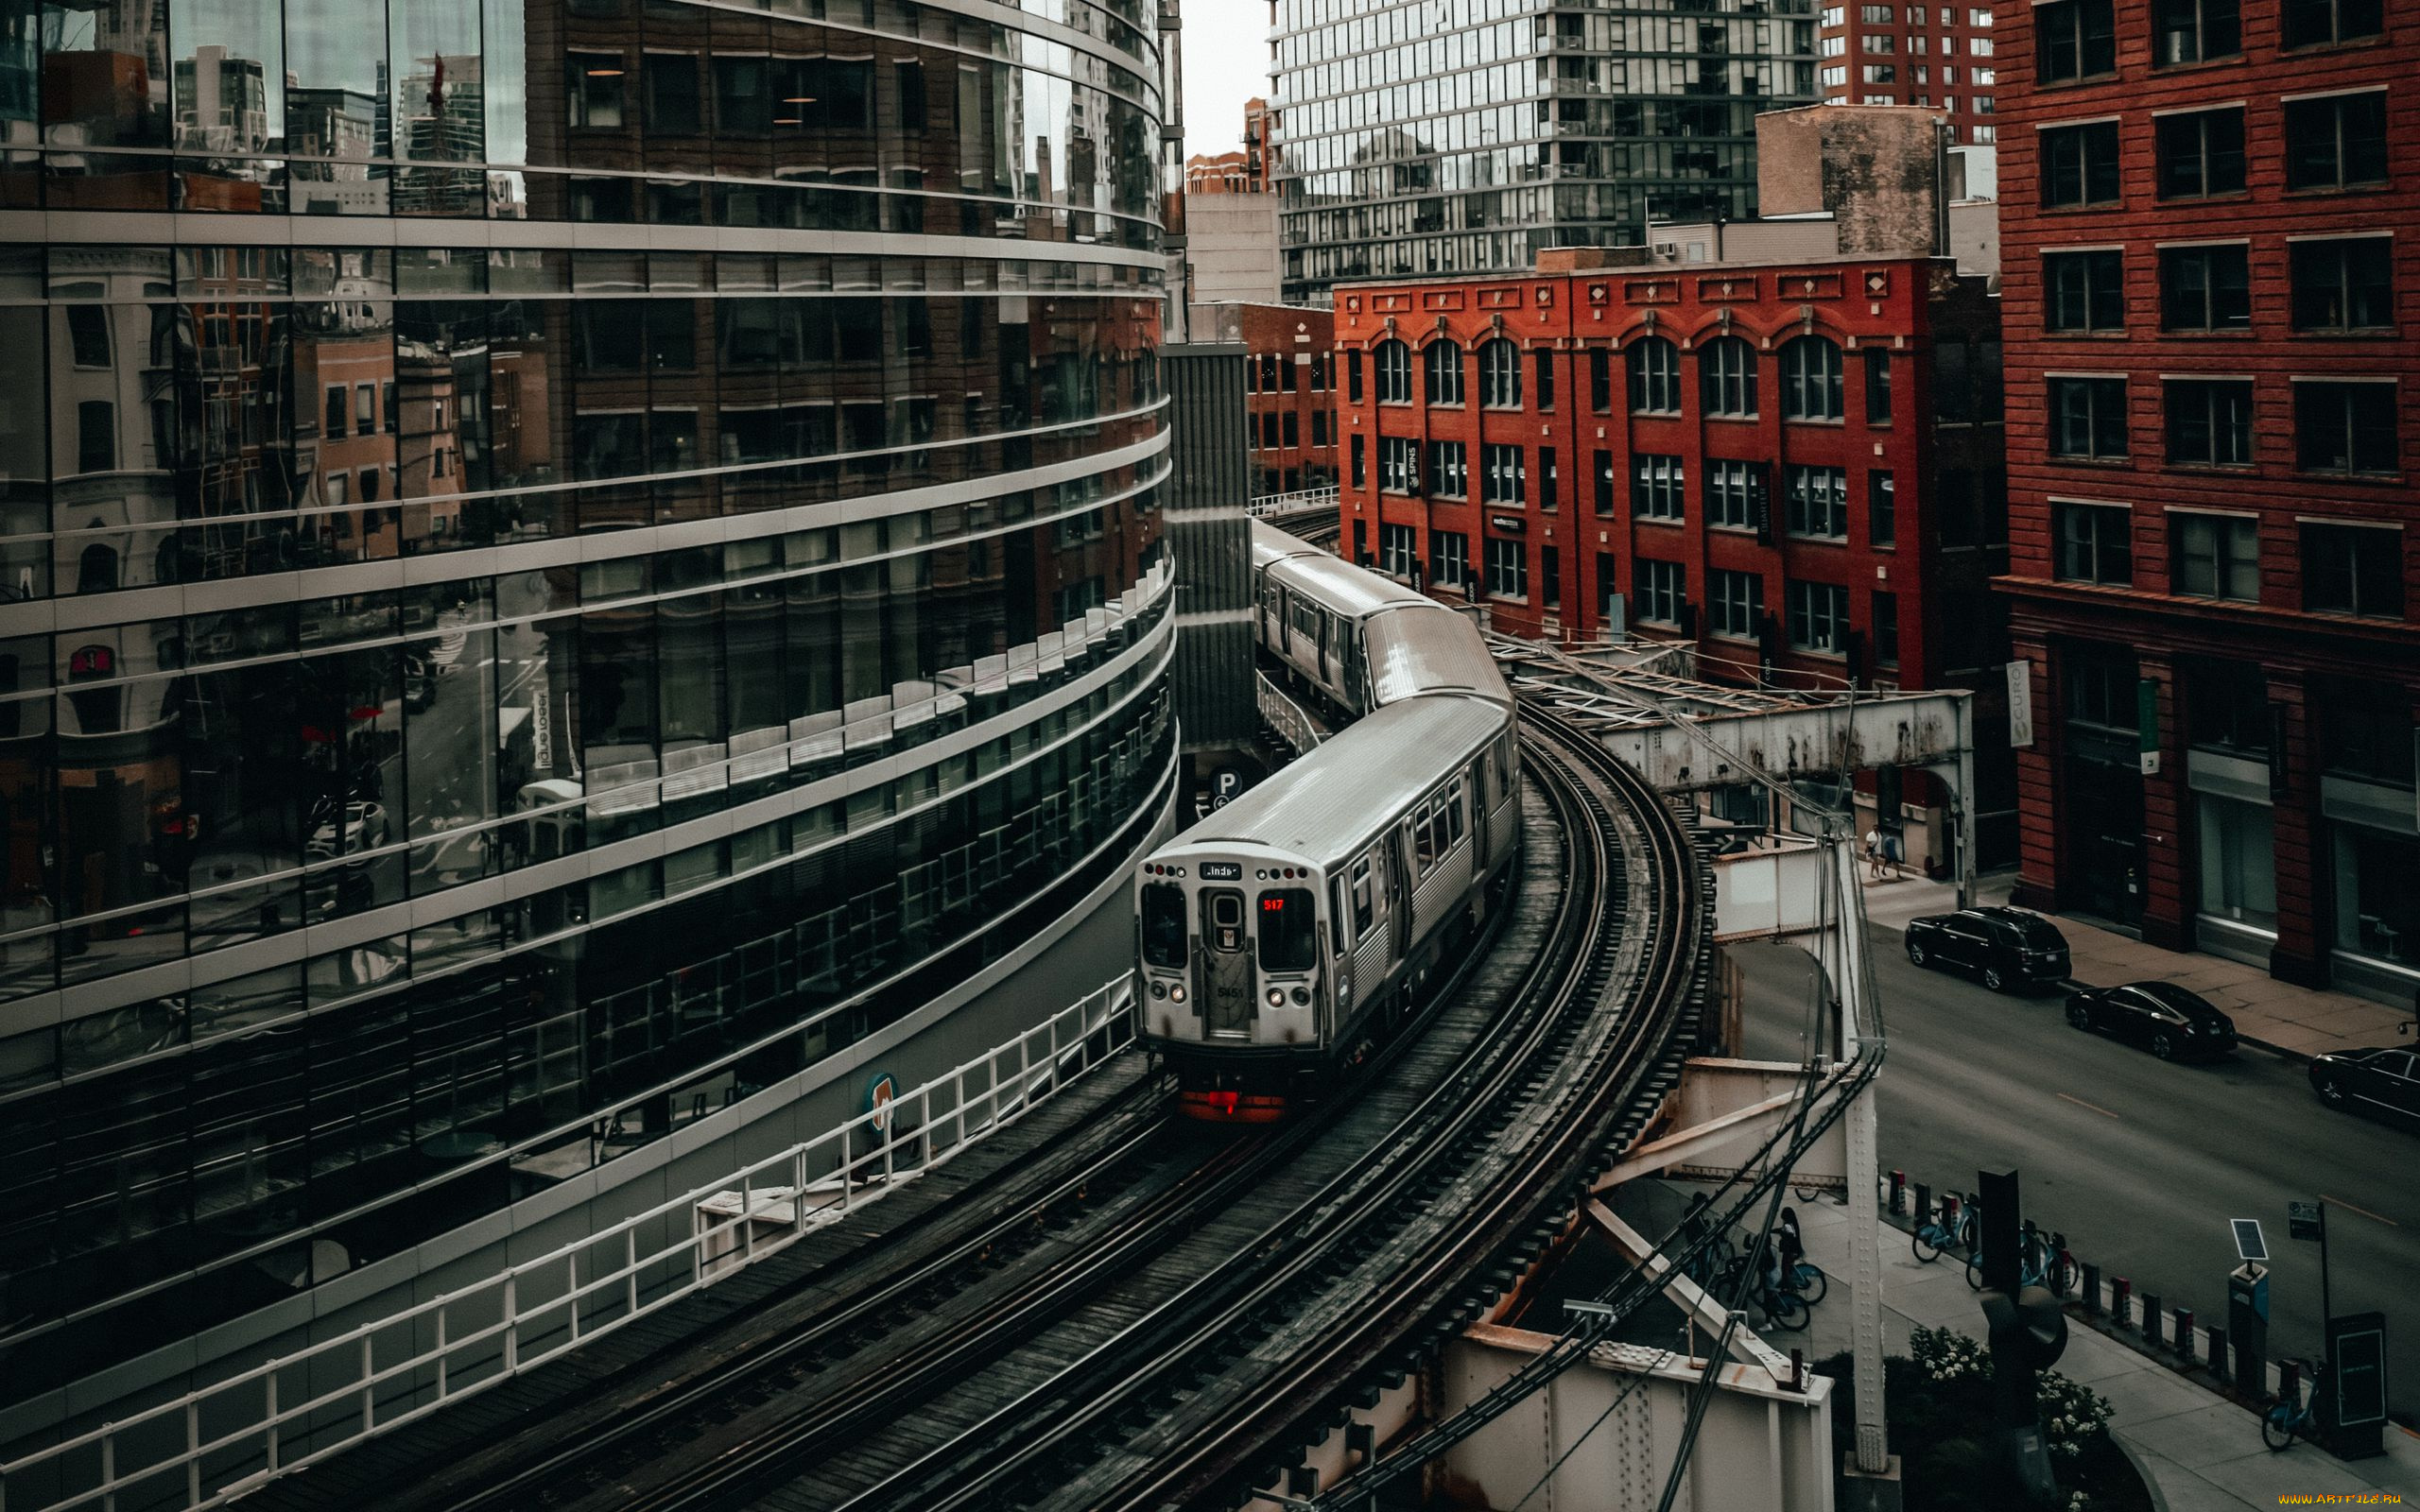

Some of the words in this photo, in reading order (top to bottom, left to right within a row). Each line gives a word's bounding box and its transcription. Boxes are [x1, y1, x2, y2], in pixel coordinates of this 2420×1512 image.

[2011, 667, 2024, 720] CURO
[1220, 773, 1236, 794] P
[1264, 900, 1284, 910] 517
